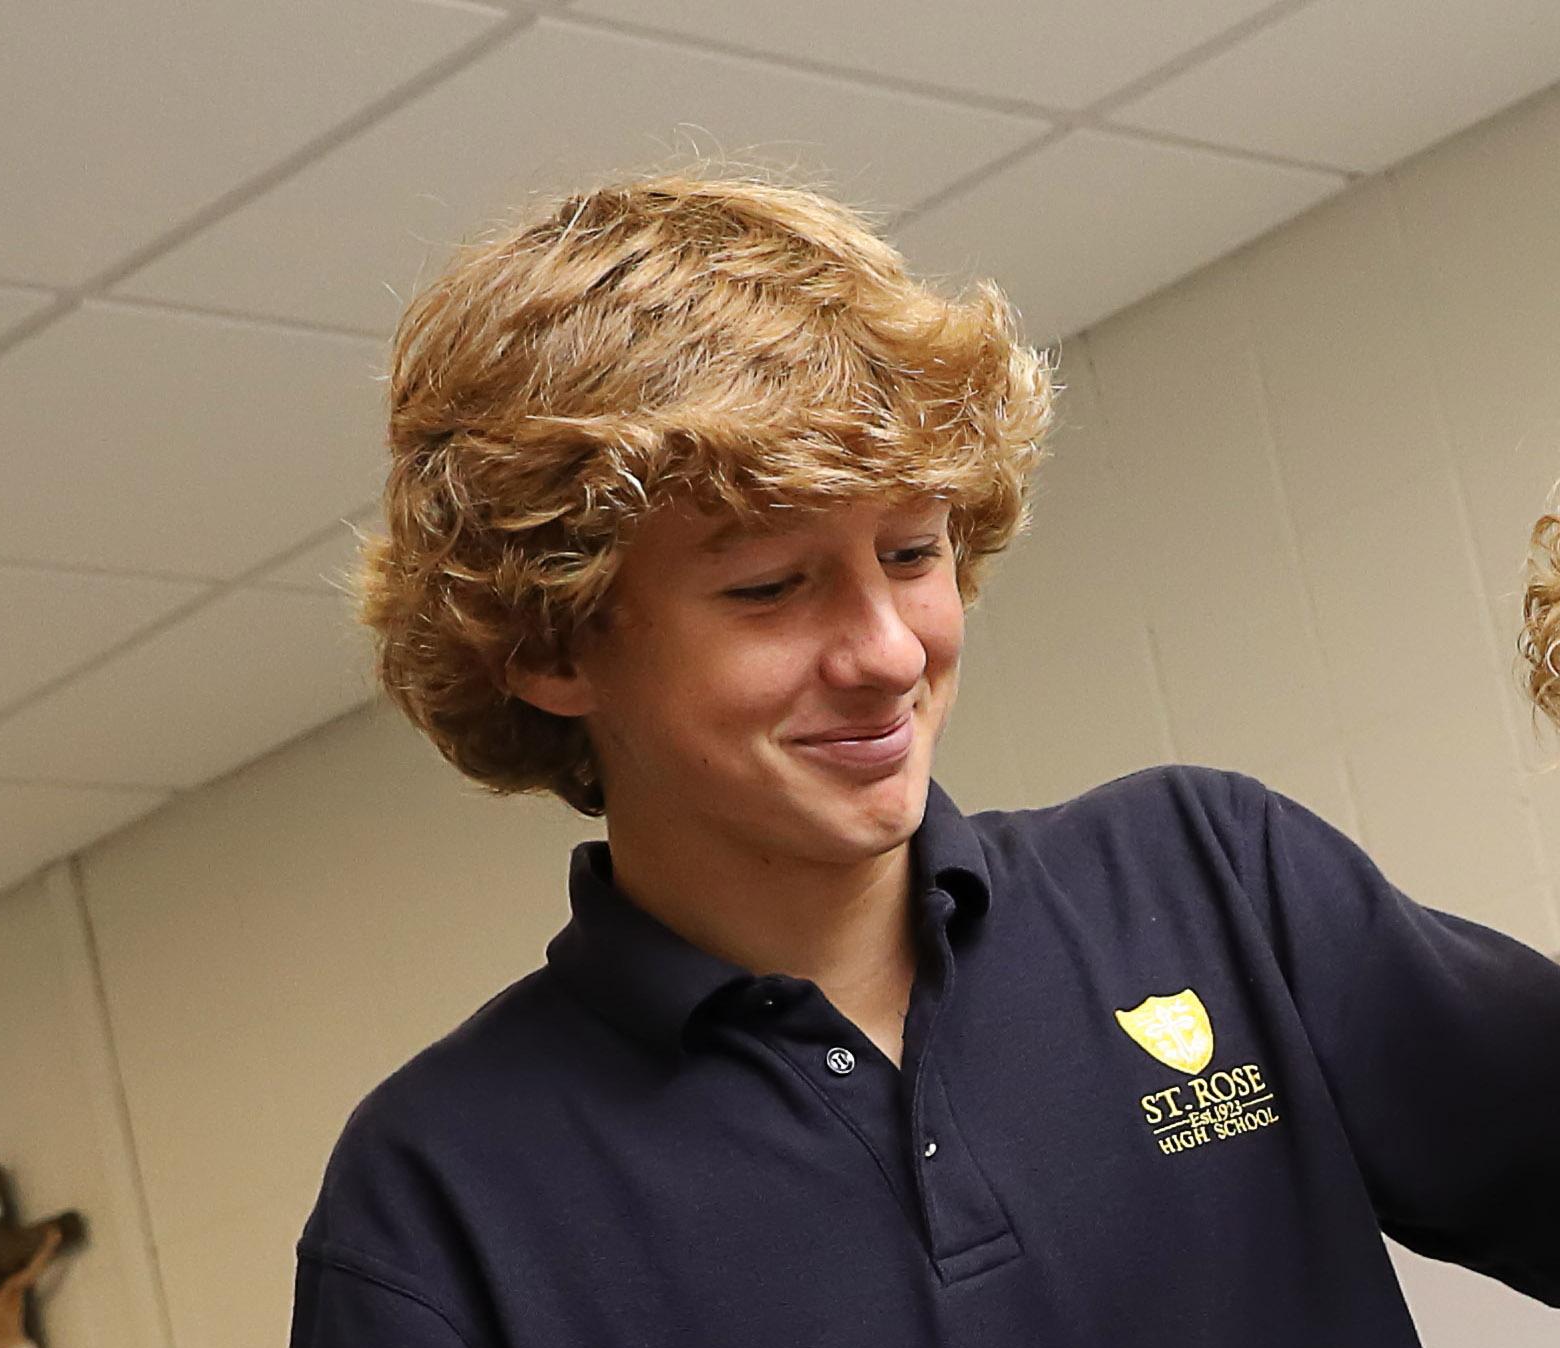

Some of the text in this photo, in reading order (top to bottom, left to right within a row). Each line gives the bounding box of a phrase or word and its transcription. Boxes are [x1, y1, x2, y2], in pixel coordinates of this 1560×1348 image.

[1140, 1064, 1266, 1124] ST. ROSE
[1158, 1106, 1280, 1155] HIGH SCHOOL
